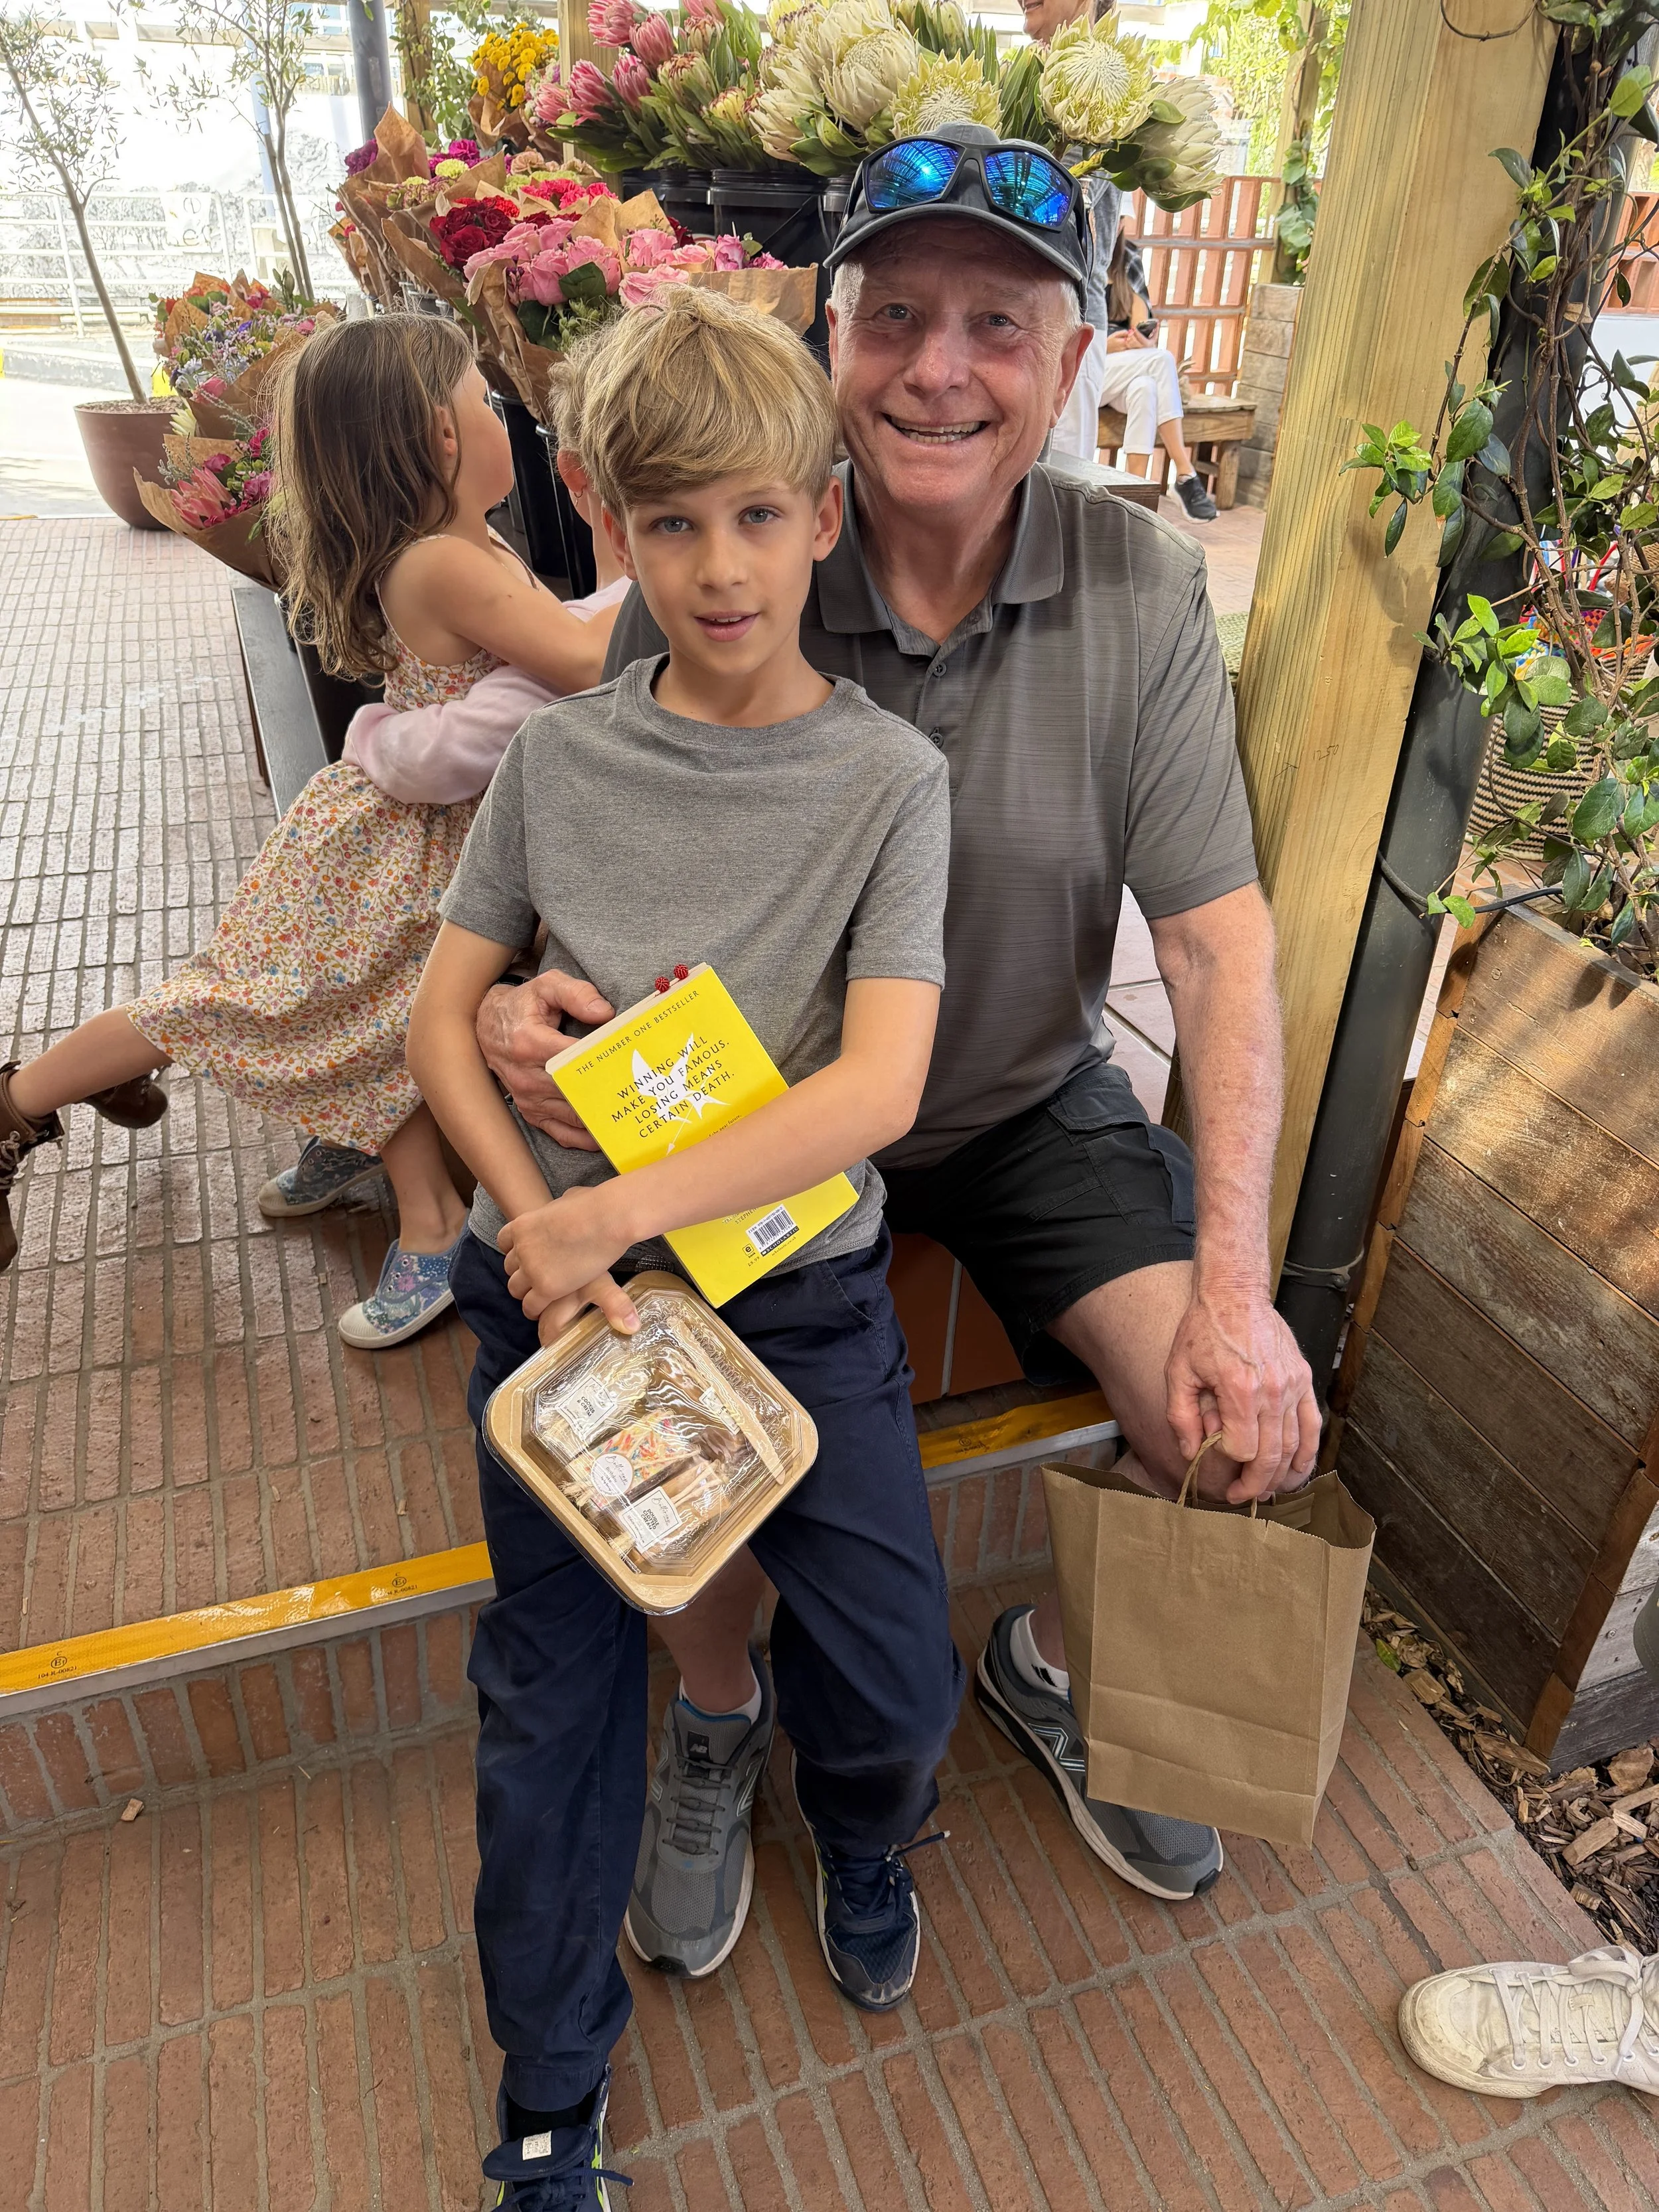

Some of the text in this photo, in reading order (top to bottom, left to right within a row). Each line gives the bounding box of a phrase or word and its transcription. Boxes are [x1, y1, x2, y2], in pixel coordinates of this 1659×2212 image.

[1313, 744, 1339, 761] 1250
[576, 990, 699, 1075] THE NUMBER ONE BESTSELLER
[611, 1039, 729, 1122] MAKE YOU FAMOUS.
[616, 1036, 707, 1099] WINNING WILL
[634, 1059, 722, 1124] LOSING MEANS
[639, 1070, 735, 1138] CERTAIN DEATH.
[766, 1226, 798, 1252] SCHOLASTIC
[642, 1510, 656, 1530] CLOTTED
[647, 1509, 660, 1526] DOUBLE
[690, 1743, 707, 1753] NB
